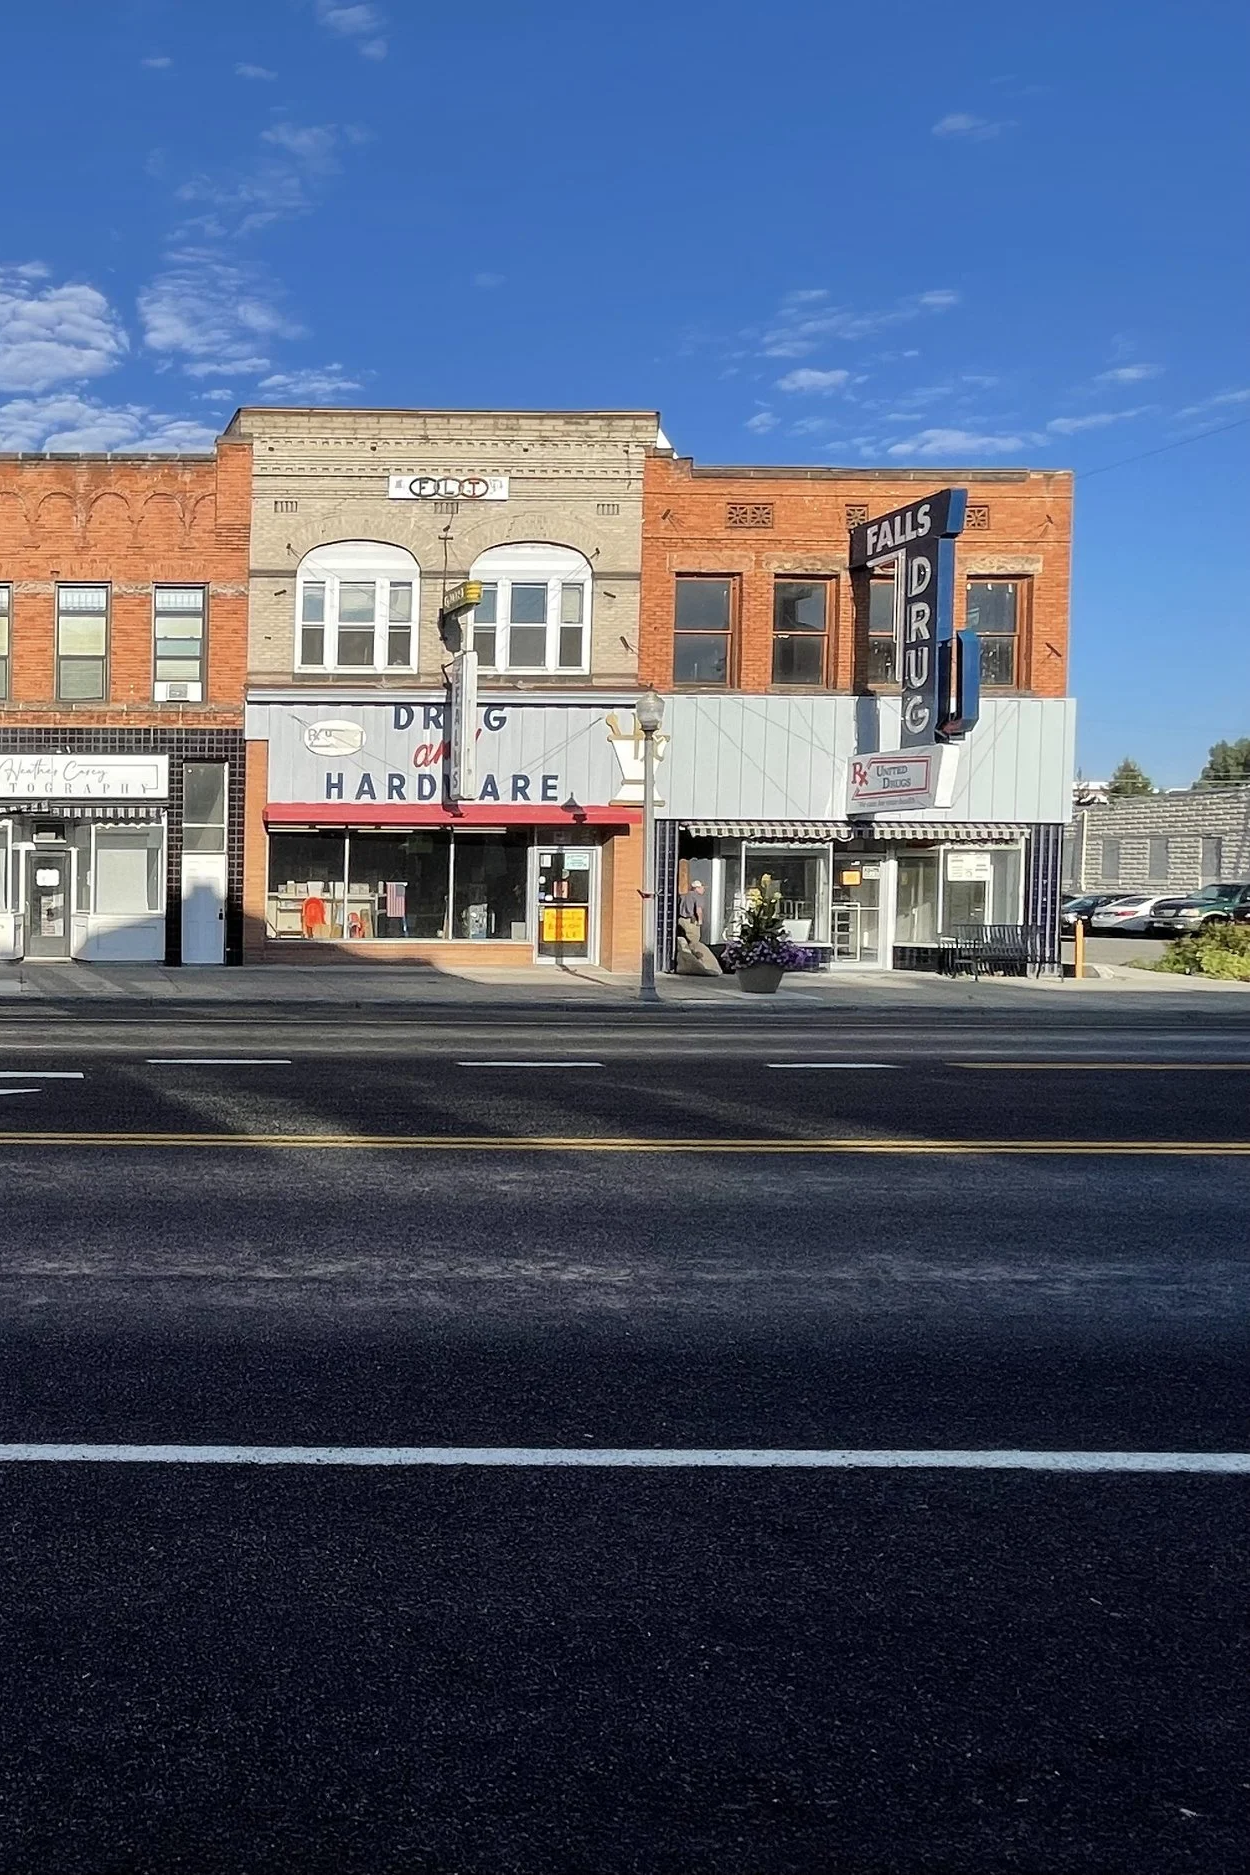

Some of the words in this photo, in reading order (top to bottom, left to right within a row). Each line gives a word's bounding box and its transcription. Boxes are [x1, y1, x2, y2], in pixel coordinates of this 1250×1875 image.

[866, 503, 932, 556] FALLS
[904, 556, 932, 735] DRUG
[393, 704, 508, 732] DRG
[326, 772, 560, 802] HARDARE
